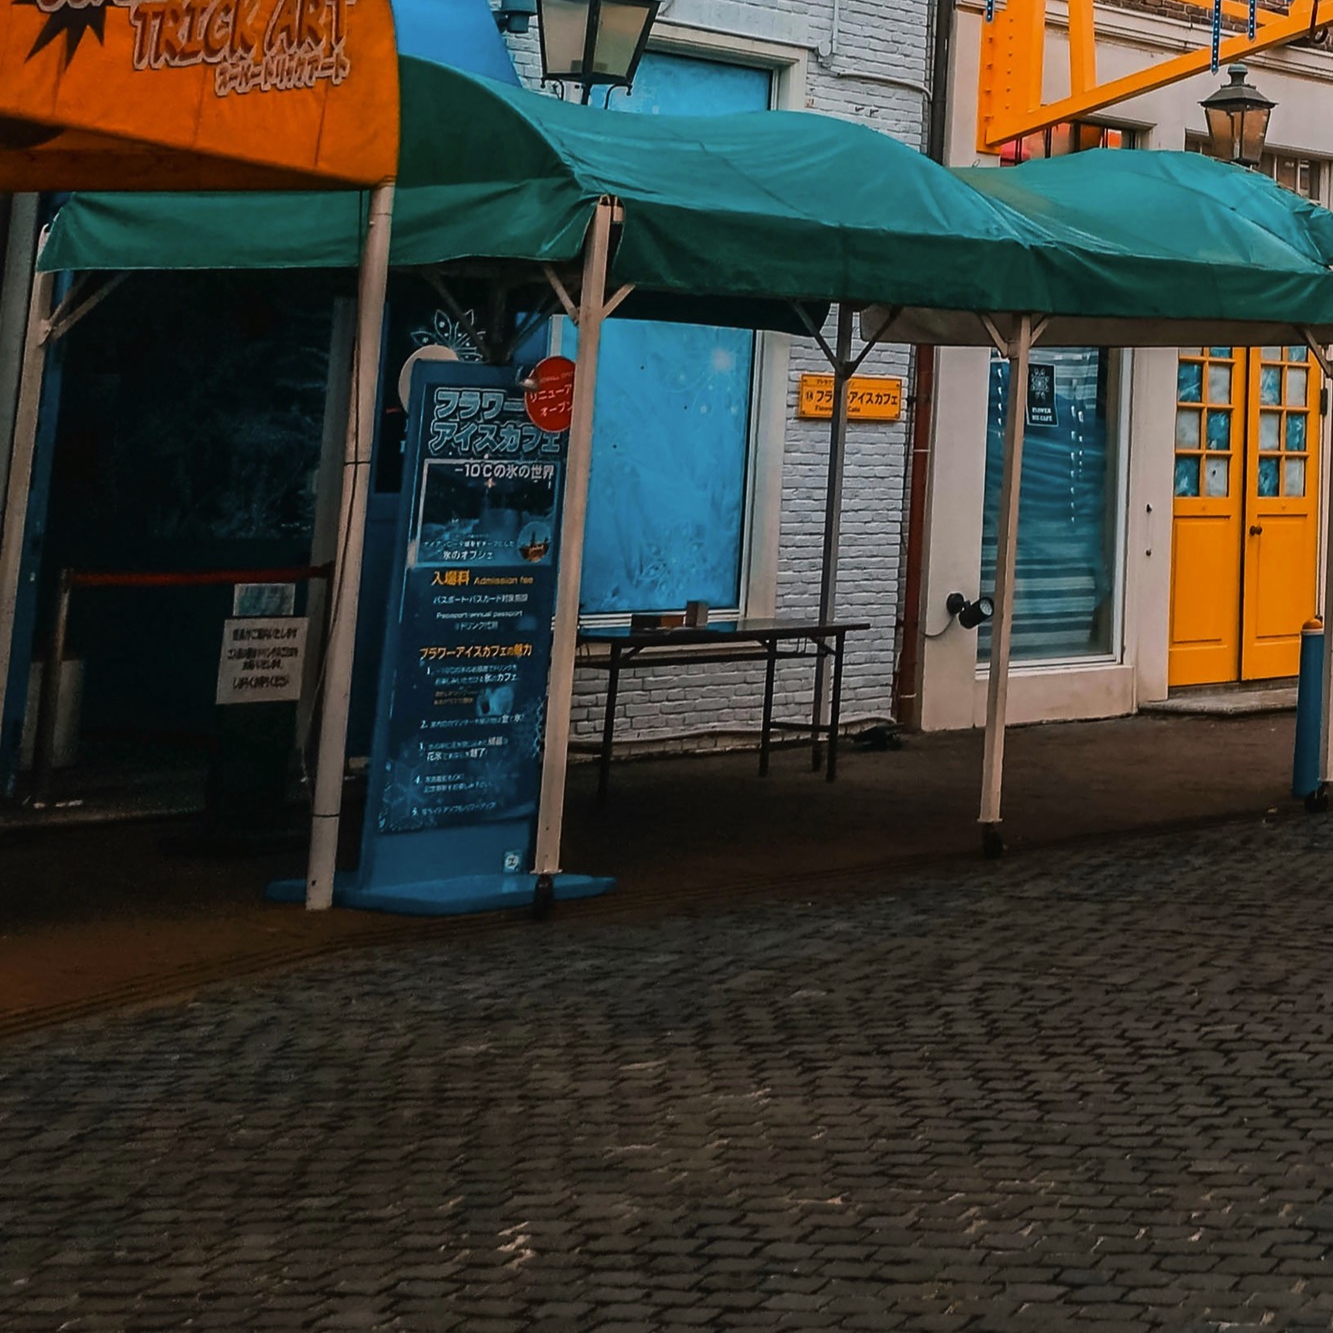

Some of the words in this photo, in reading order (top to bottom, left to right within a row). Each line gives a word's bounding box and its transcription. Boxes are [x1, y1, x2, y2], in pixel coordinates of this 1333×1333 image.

[529, 383, 573, 403] リニューア
[816, 390, 898, 405] フラアイスカフェ
[434, 387, 525, 420] フラワー
[429, 421, 562, 457] アイスカフェ
[431, 569, 470, 586] 入場料
[473, 577, 518, 585] Admission
[520, 576, 533, 584] fee
